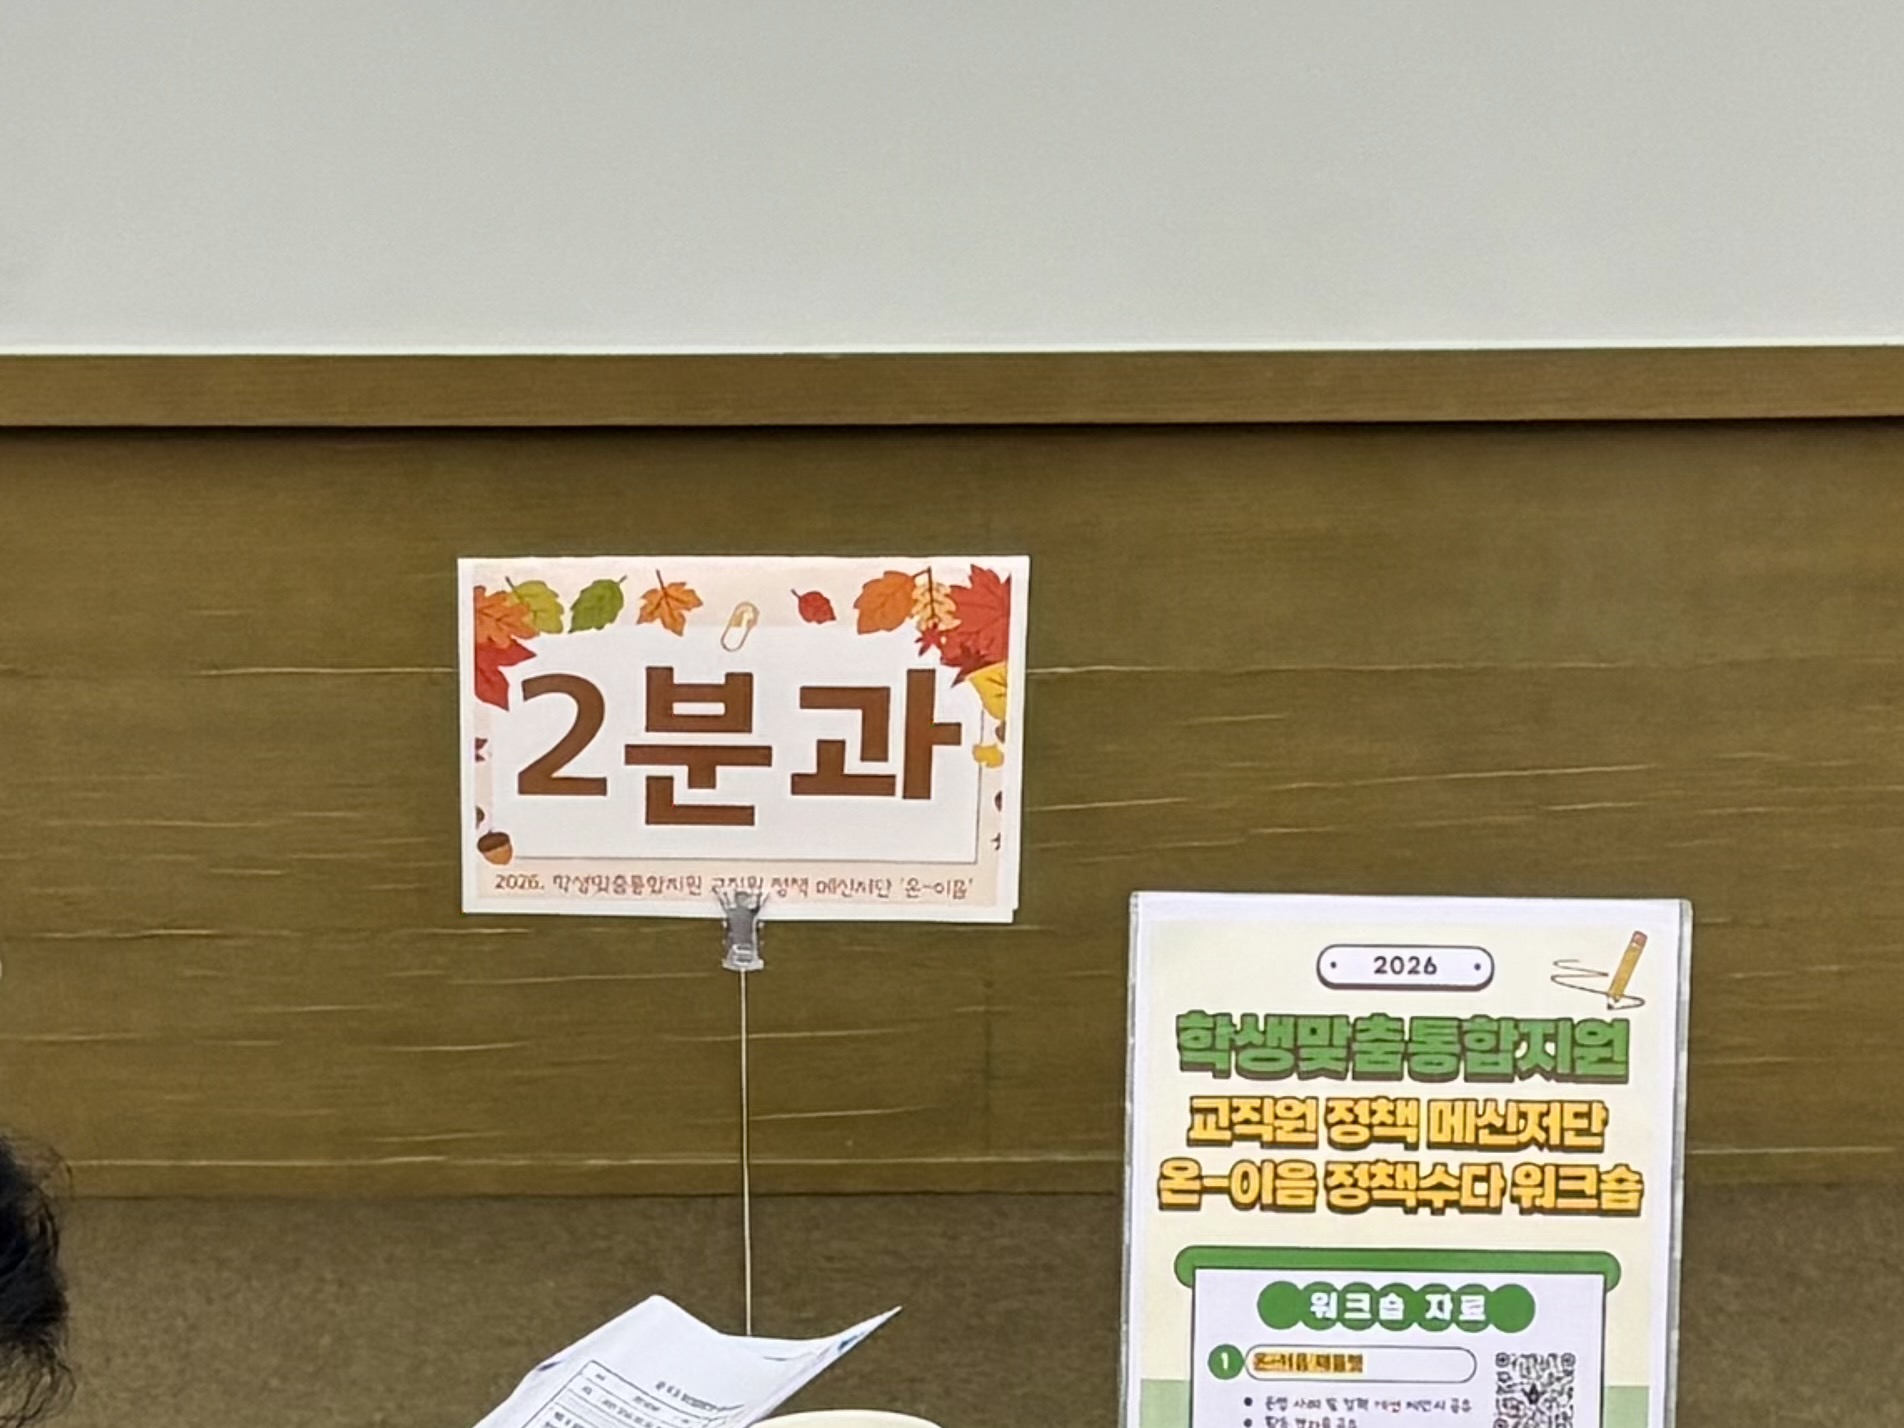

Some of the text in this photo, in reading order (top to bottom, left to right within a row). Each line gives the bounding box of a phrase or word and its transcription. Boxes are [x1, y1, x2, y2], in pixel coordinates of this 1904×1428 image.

[516, 666, 963, 826] 2분과
[495, 873, 545, 891] 2026.
[1373, 955, 1438, 976] 2026
[1175, 1009, 1631, 1084] 학생맞춤통합지원
[1187, 1096, 1609, 1153] 교직원 정책 메신저단
[1157, 1157, 1317, 1213] 온-이음
[1323, 1160, 1507, 1215] 정책수다
[1424, 1292, 1488, 1323] 자료
